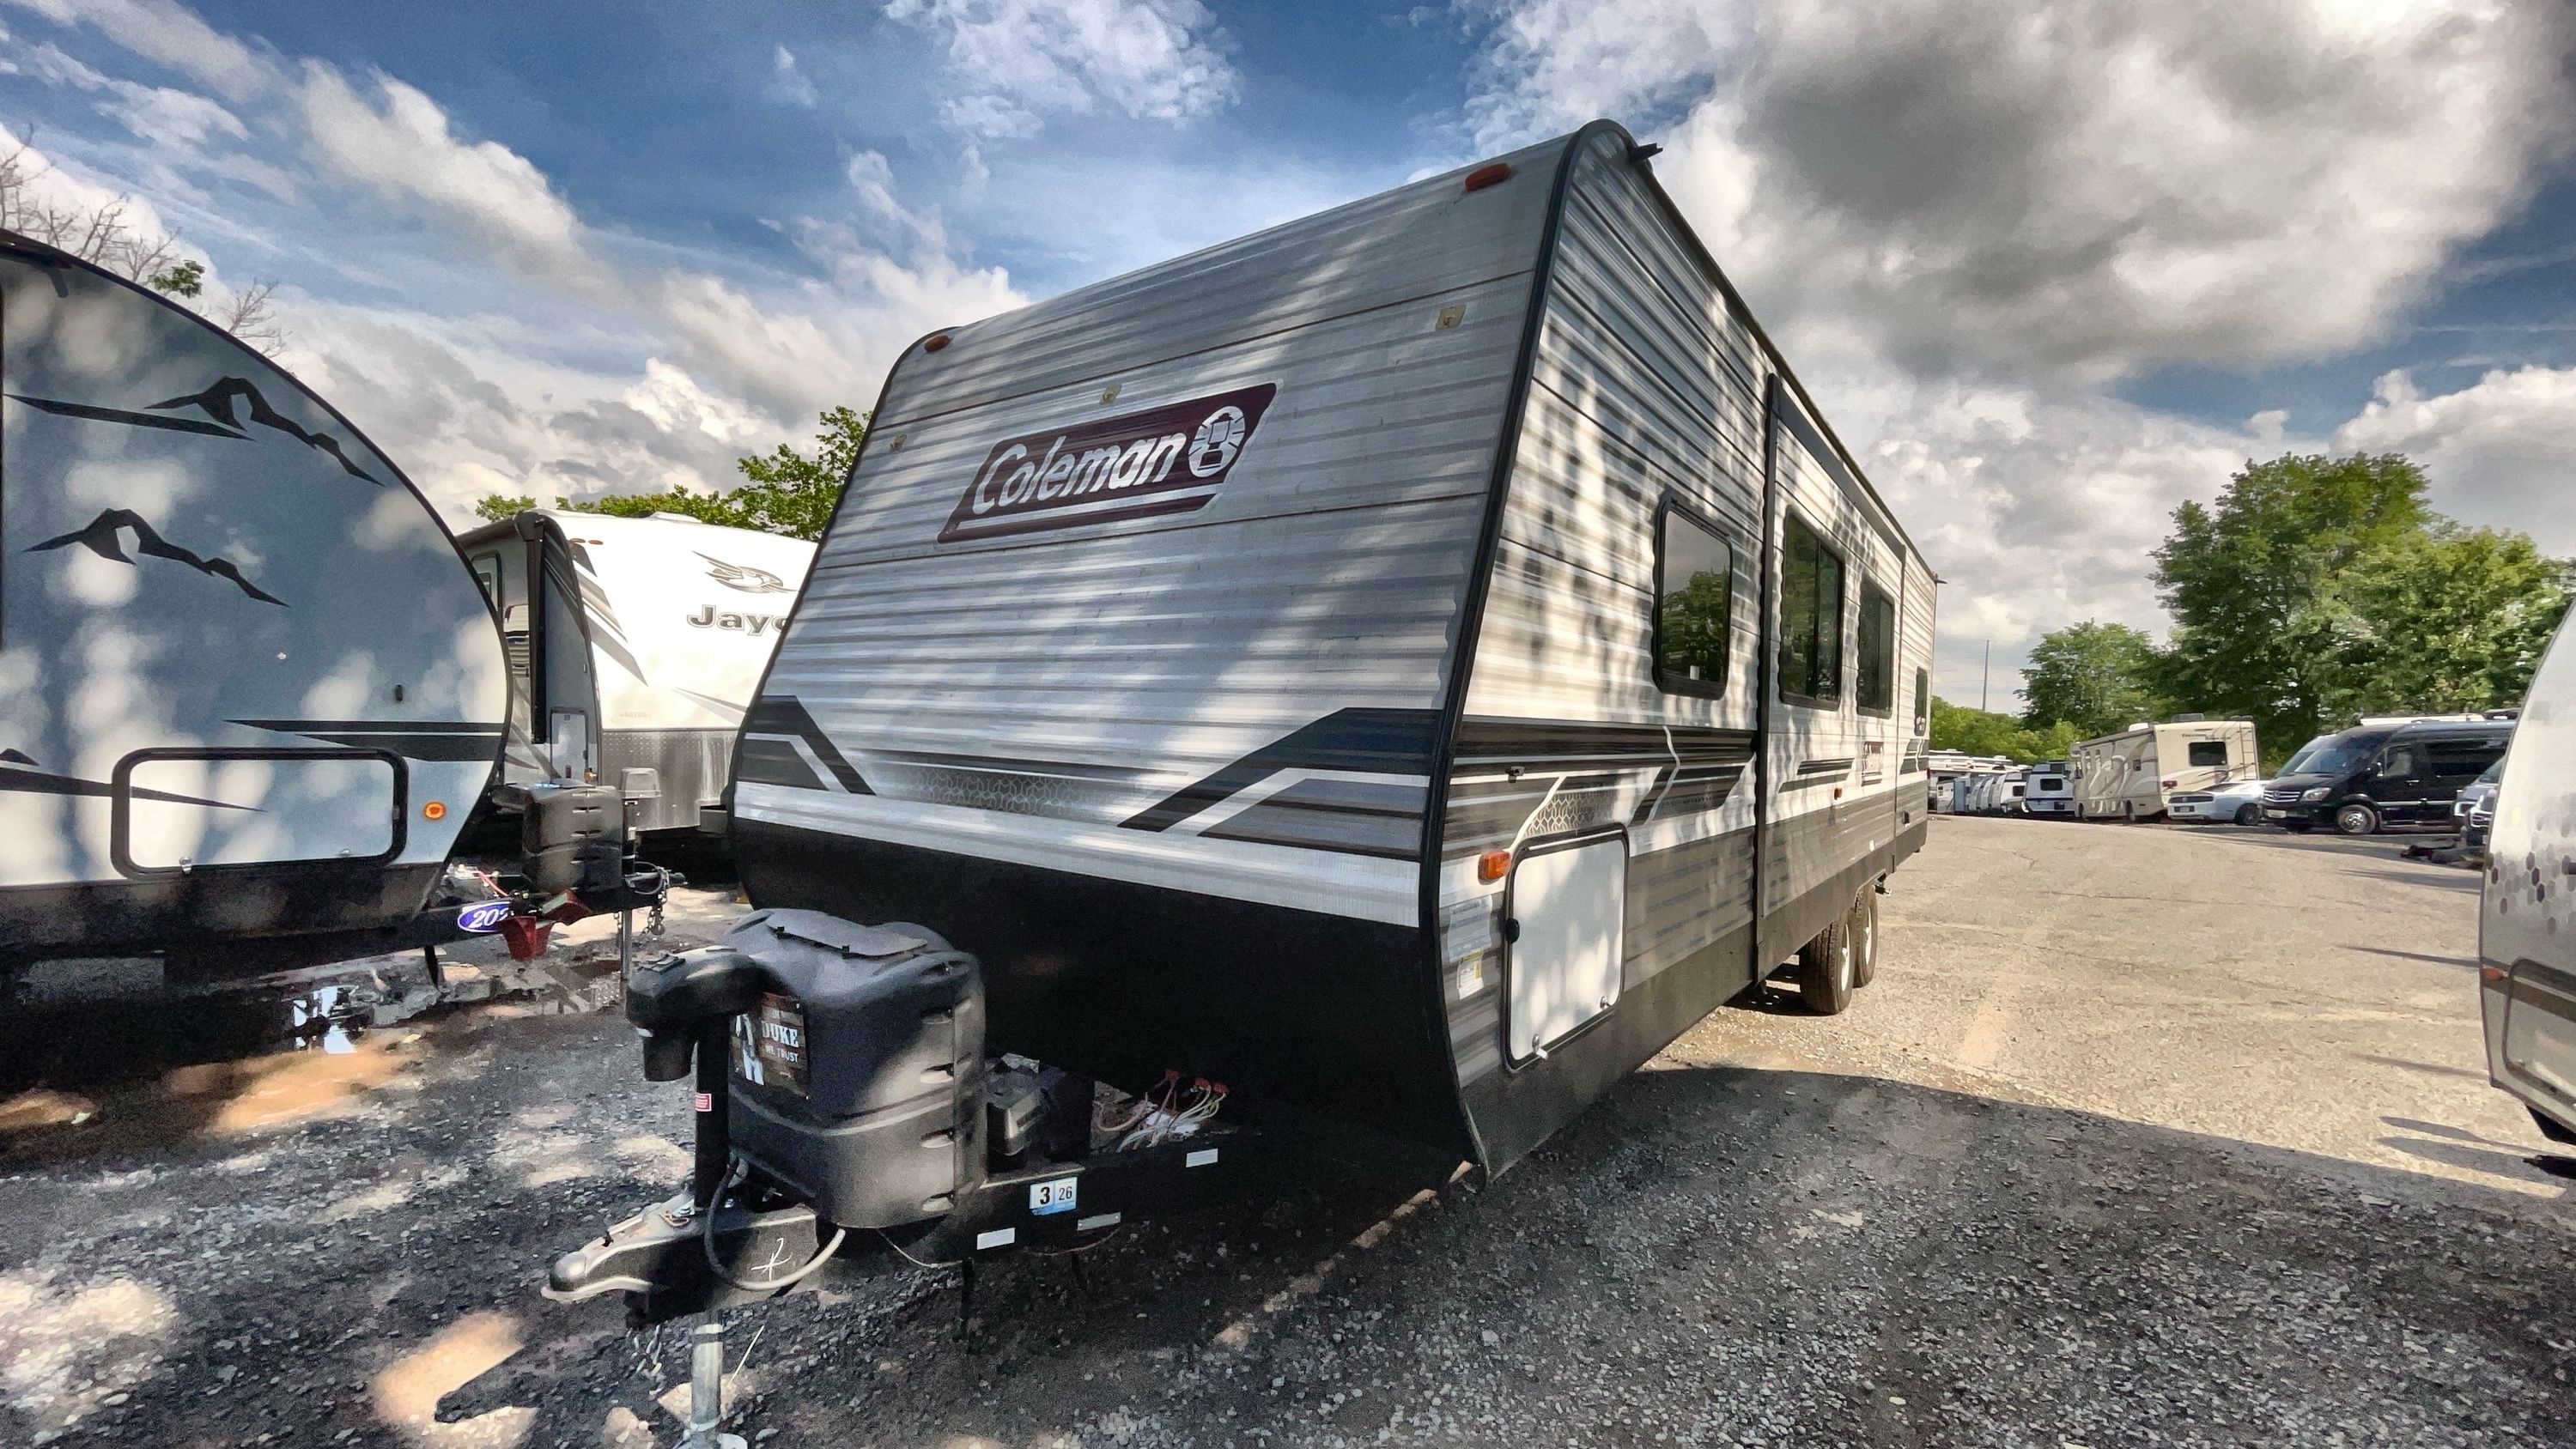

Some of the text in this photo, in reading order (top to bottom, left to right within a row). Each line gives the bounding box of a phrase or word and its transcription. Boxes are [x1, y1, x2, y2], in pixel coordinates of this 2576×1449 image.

[972, 432, 1187, 515] Coleman
[761, 1021, 799, 1048] DUKE
[777, 1048, 799, 1062] TRUST
[1040, 1186, 1072, 1204] 3 26
